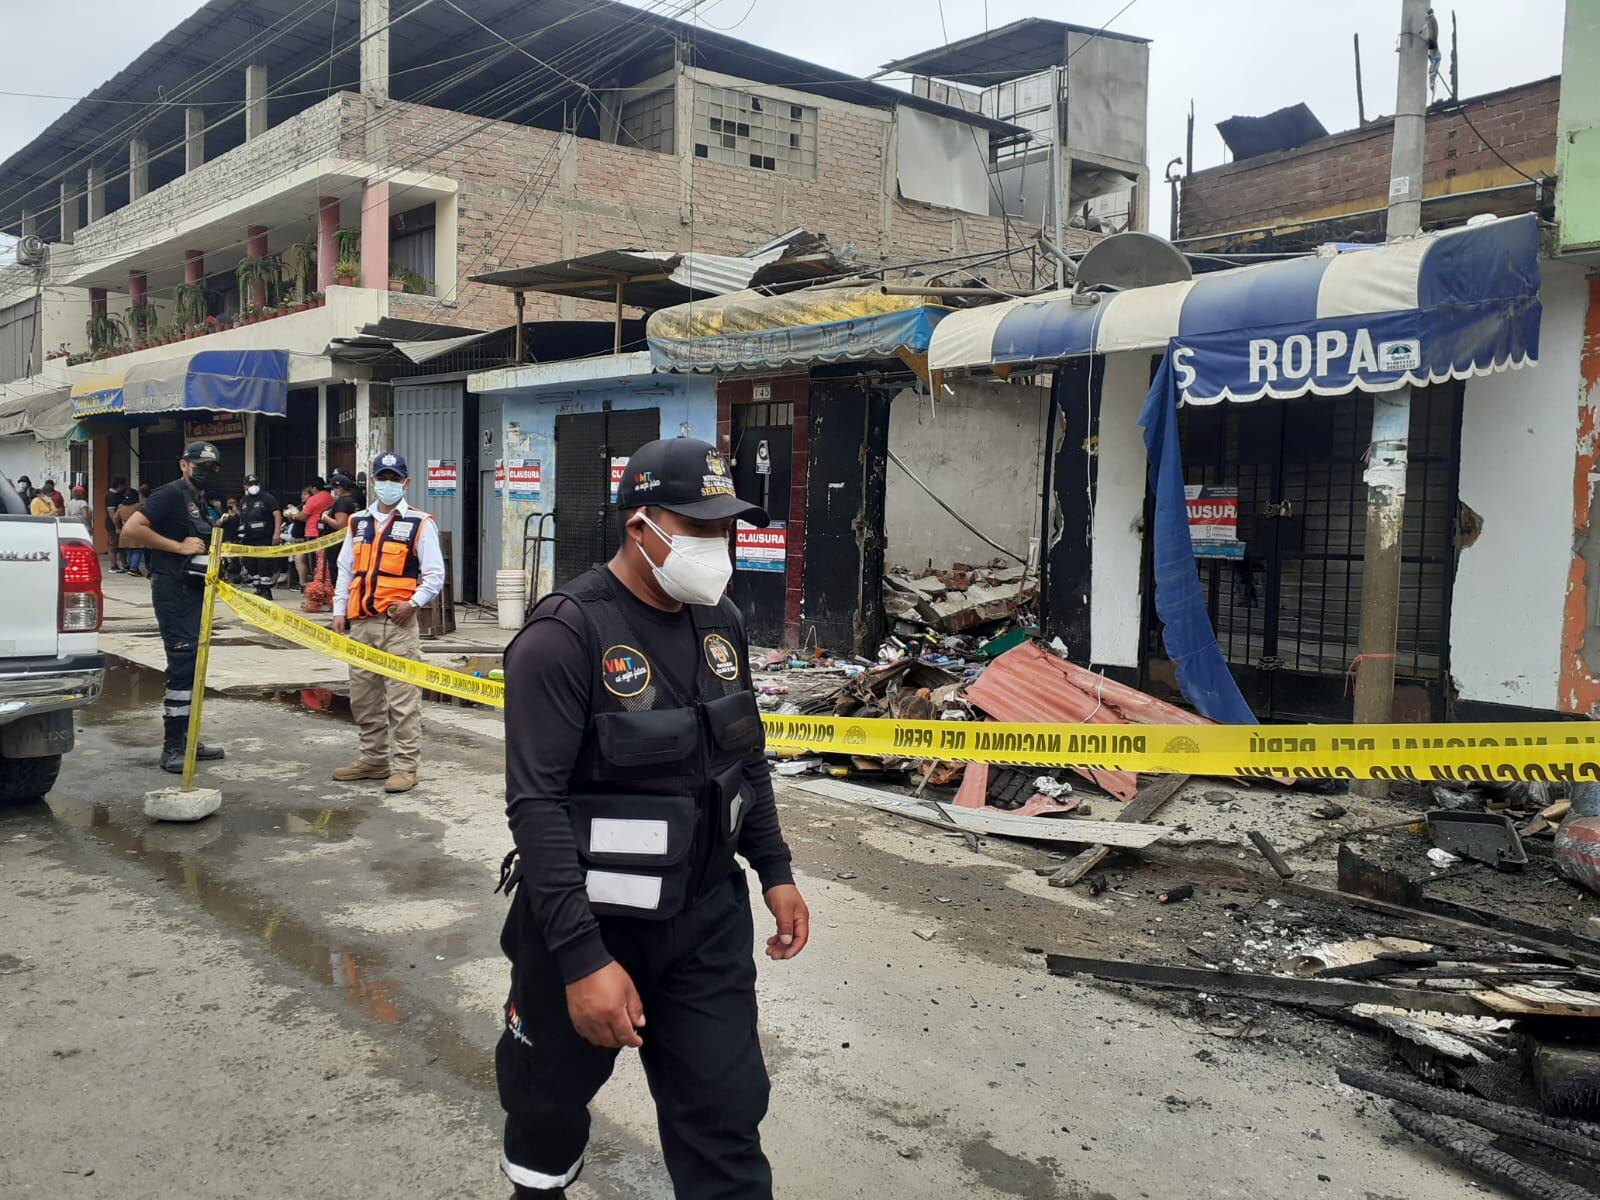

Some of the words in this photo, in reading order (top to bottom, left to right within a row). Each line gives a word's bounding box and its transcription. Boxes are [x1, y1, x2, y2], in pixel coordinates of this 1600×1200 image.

[1172, 347, 1196, 389] S
[1249, 328, 1378, 382] ROPA
[509, 470, 540, 479] CLAUSURA
[737, 533, 785, 544] CLAUSURA
[605, 657, 632, 673] VMT
